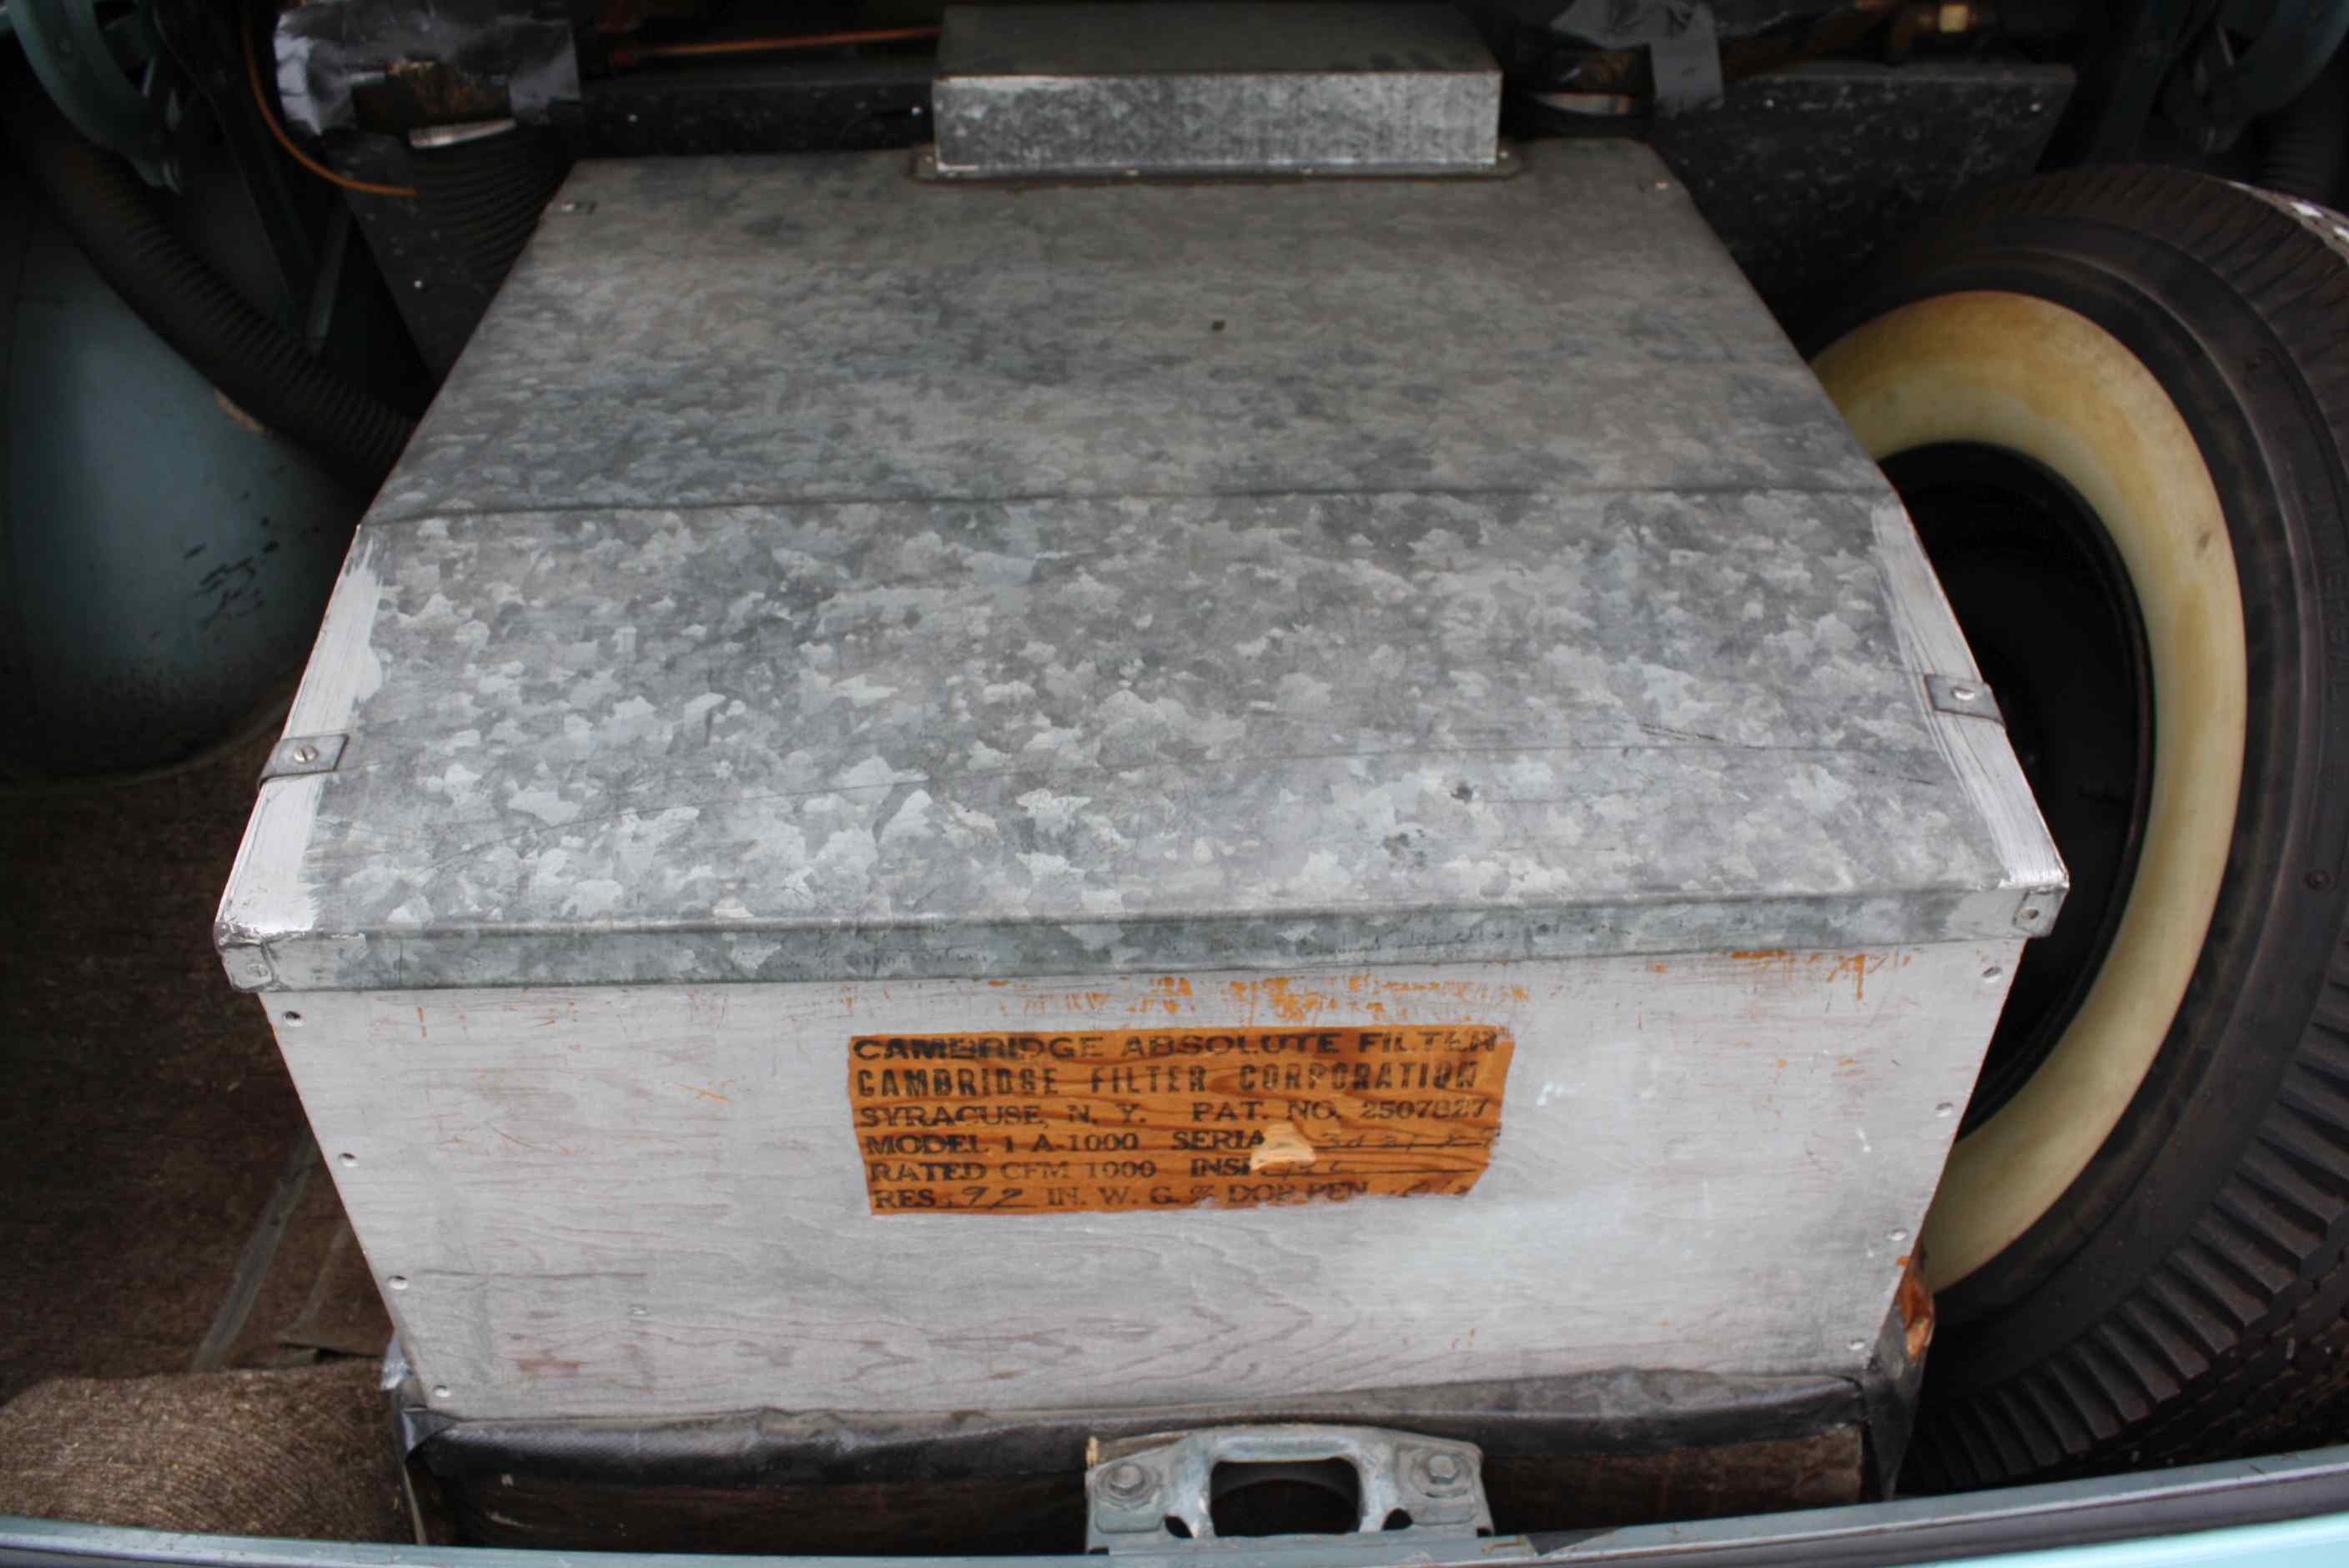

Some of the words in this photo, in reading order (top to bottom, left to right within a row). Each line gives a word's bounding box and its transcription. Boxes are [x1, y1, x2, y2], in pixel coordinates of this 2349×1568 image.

[853, 1036, 1104, 1060] CAMBRIDGE
[1120, 1033, 1341, 1058] ABSOLUTE
[1359, 1031, 1498, 1053] FILTER
[858, 1067, 1059, 1097] CAMBRIDGE
[1091, 1064, 1207, 1093] FILTER
[1239, 1060, 1480, 1092] CORPORATION
[1116, 1103, 1148, 1124] Y.
[1191, 1100, 1269, 1122] PAT.
[866, 1133, 989, 1154] MODEL
[1172, 1129, 1266, 1151] SERIA
[869, 1159, 987, 1182] RATED
[1000, 1159, 1071, 1180] CFM
[1087, 1159, 1158, 1179] 1000
